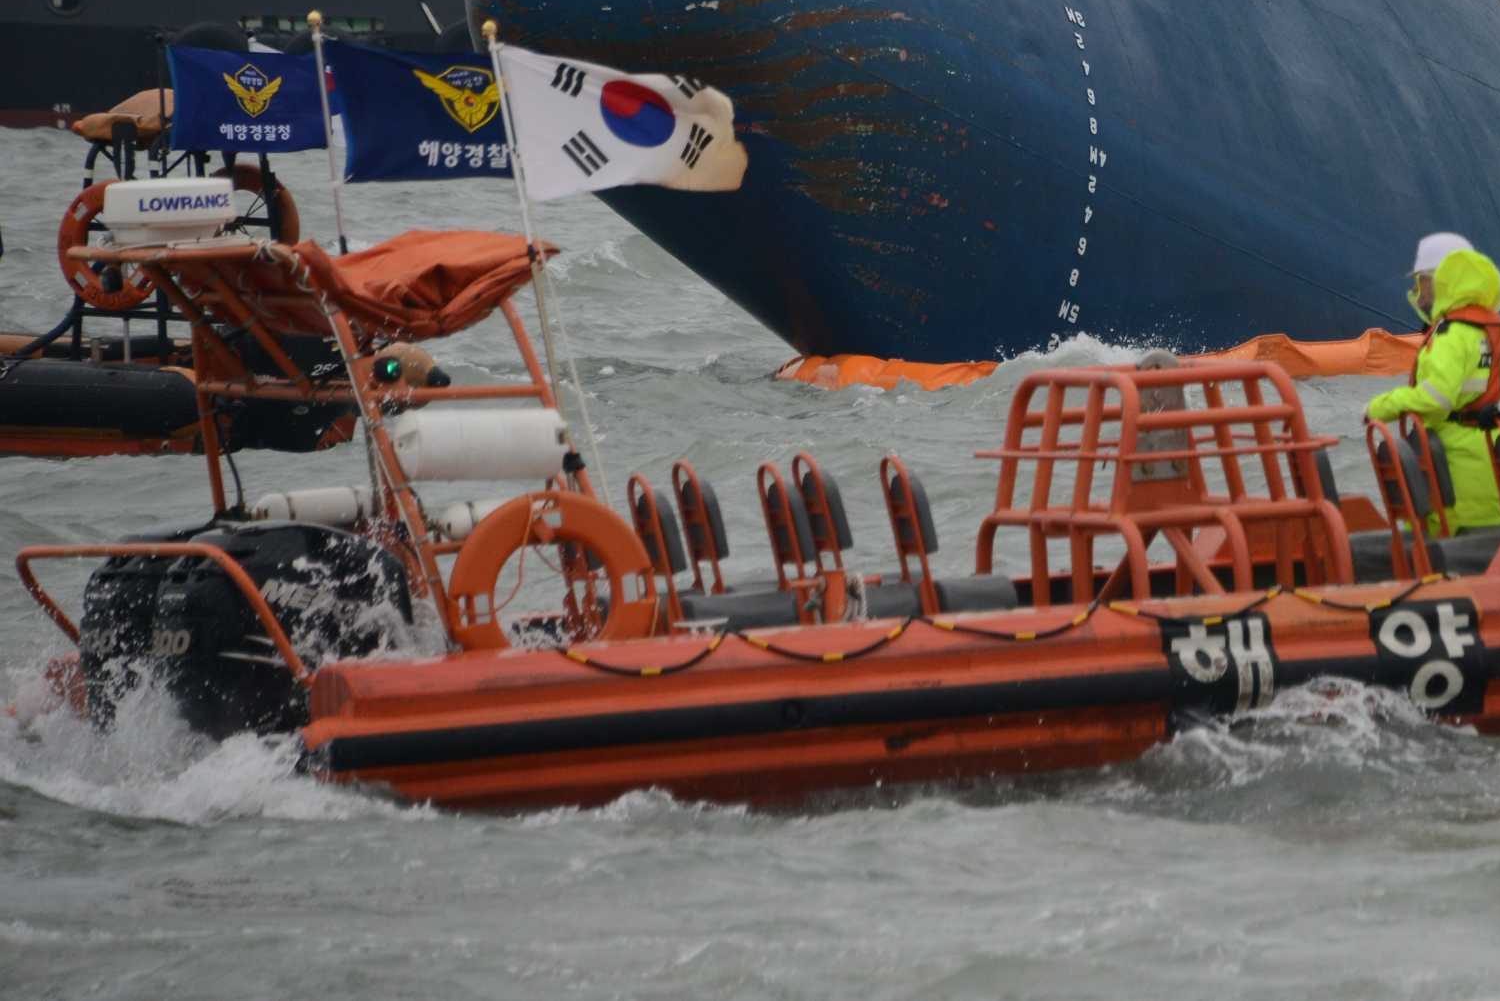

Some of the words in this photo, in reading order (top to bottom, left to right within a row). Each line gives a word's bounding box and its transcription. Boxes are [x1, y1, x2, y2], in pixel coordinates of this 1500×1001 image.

[219, 123, 291, 141] 해양경찰청
[1089, 117, 1098, 135] 8
[1089, 145, 1107, 168] 4M
[1088, 174, 1097, 194] 2
[139, 194, 230, 212] LOWRANCE
[1084, 206, 1093, 224] 4
[1077, 236, 1087, 256] 6
[1069, 268, 1080, 287] 8
[1058, 299, 1080, 324] 5M
